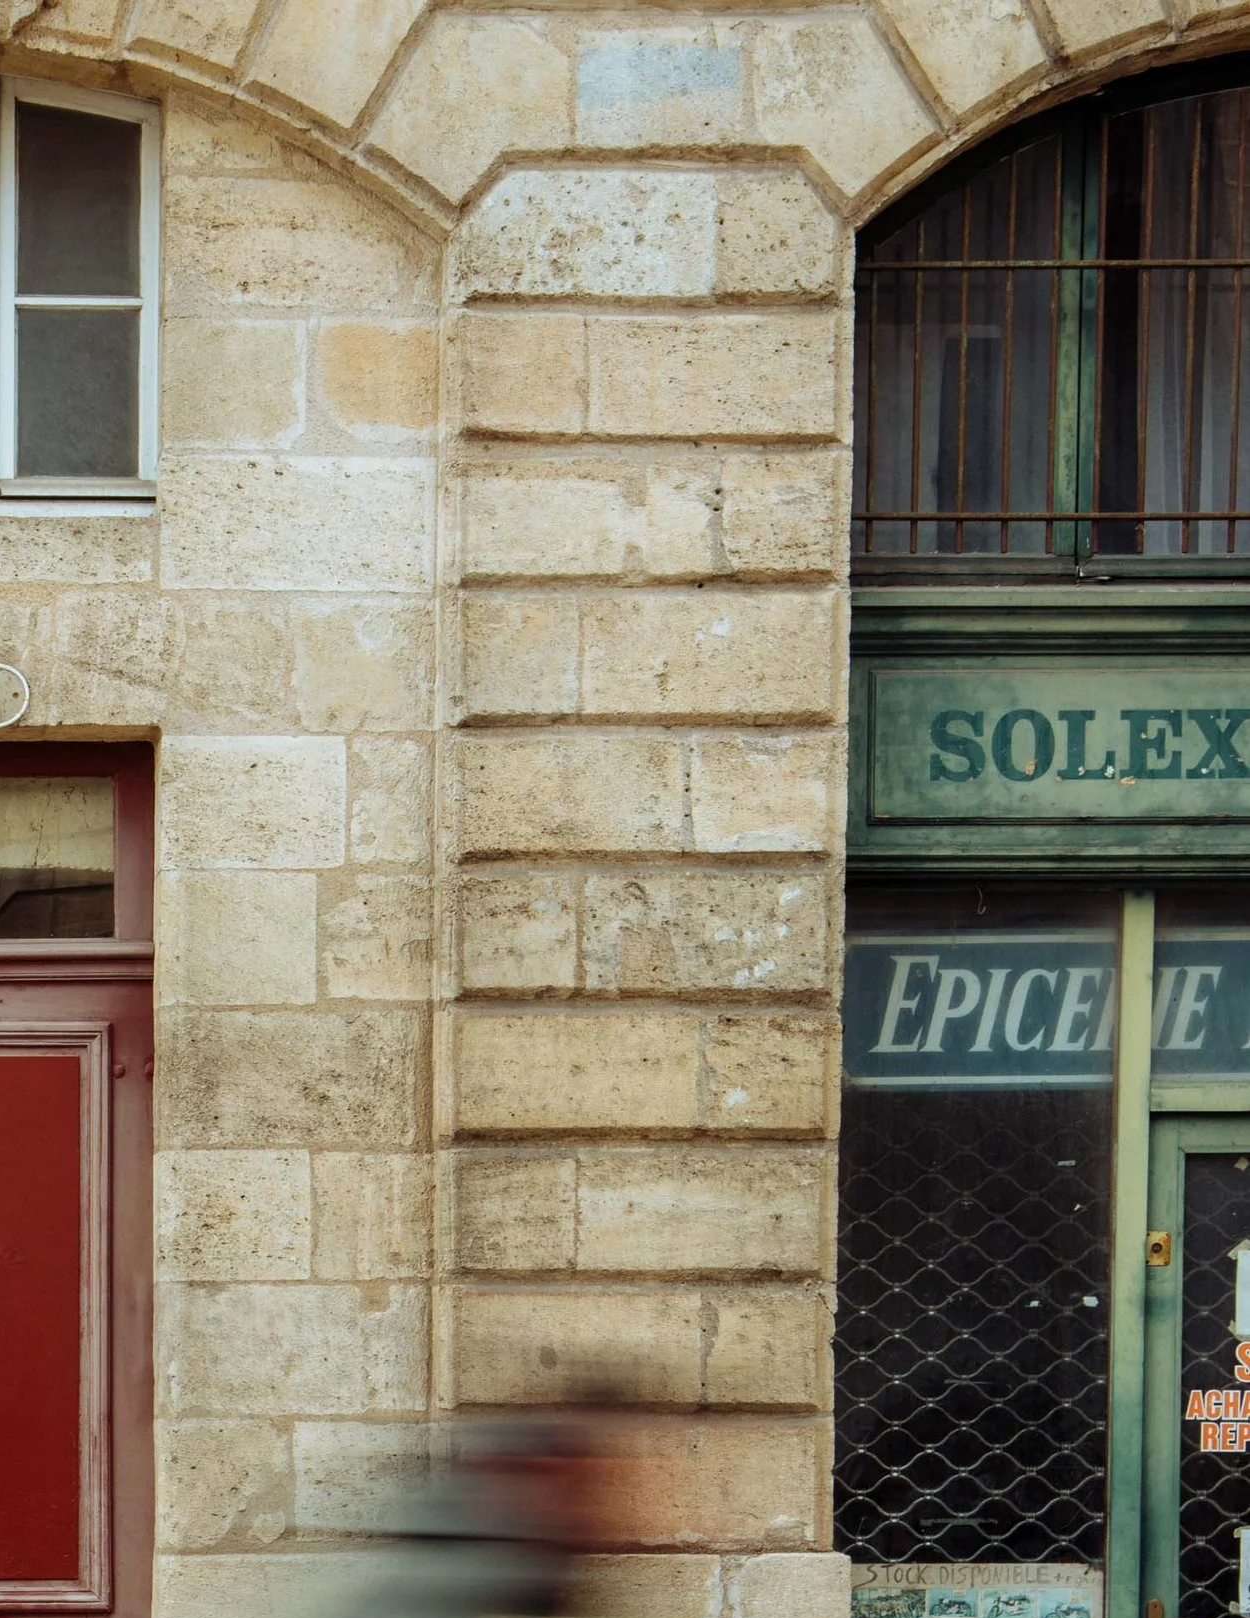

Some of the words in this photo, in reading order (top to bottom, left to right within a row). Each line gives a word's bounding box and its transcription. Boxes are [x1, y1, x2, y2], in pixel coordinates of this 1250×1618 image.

[930, 708, 1250, 782] SOLEX
[1200, 1422, 1250, 1452] REP
[851, 1564, 927, 1589] STOCK
[939, 1564, 1050, 1588] DISPONIBLE
